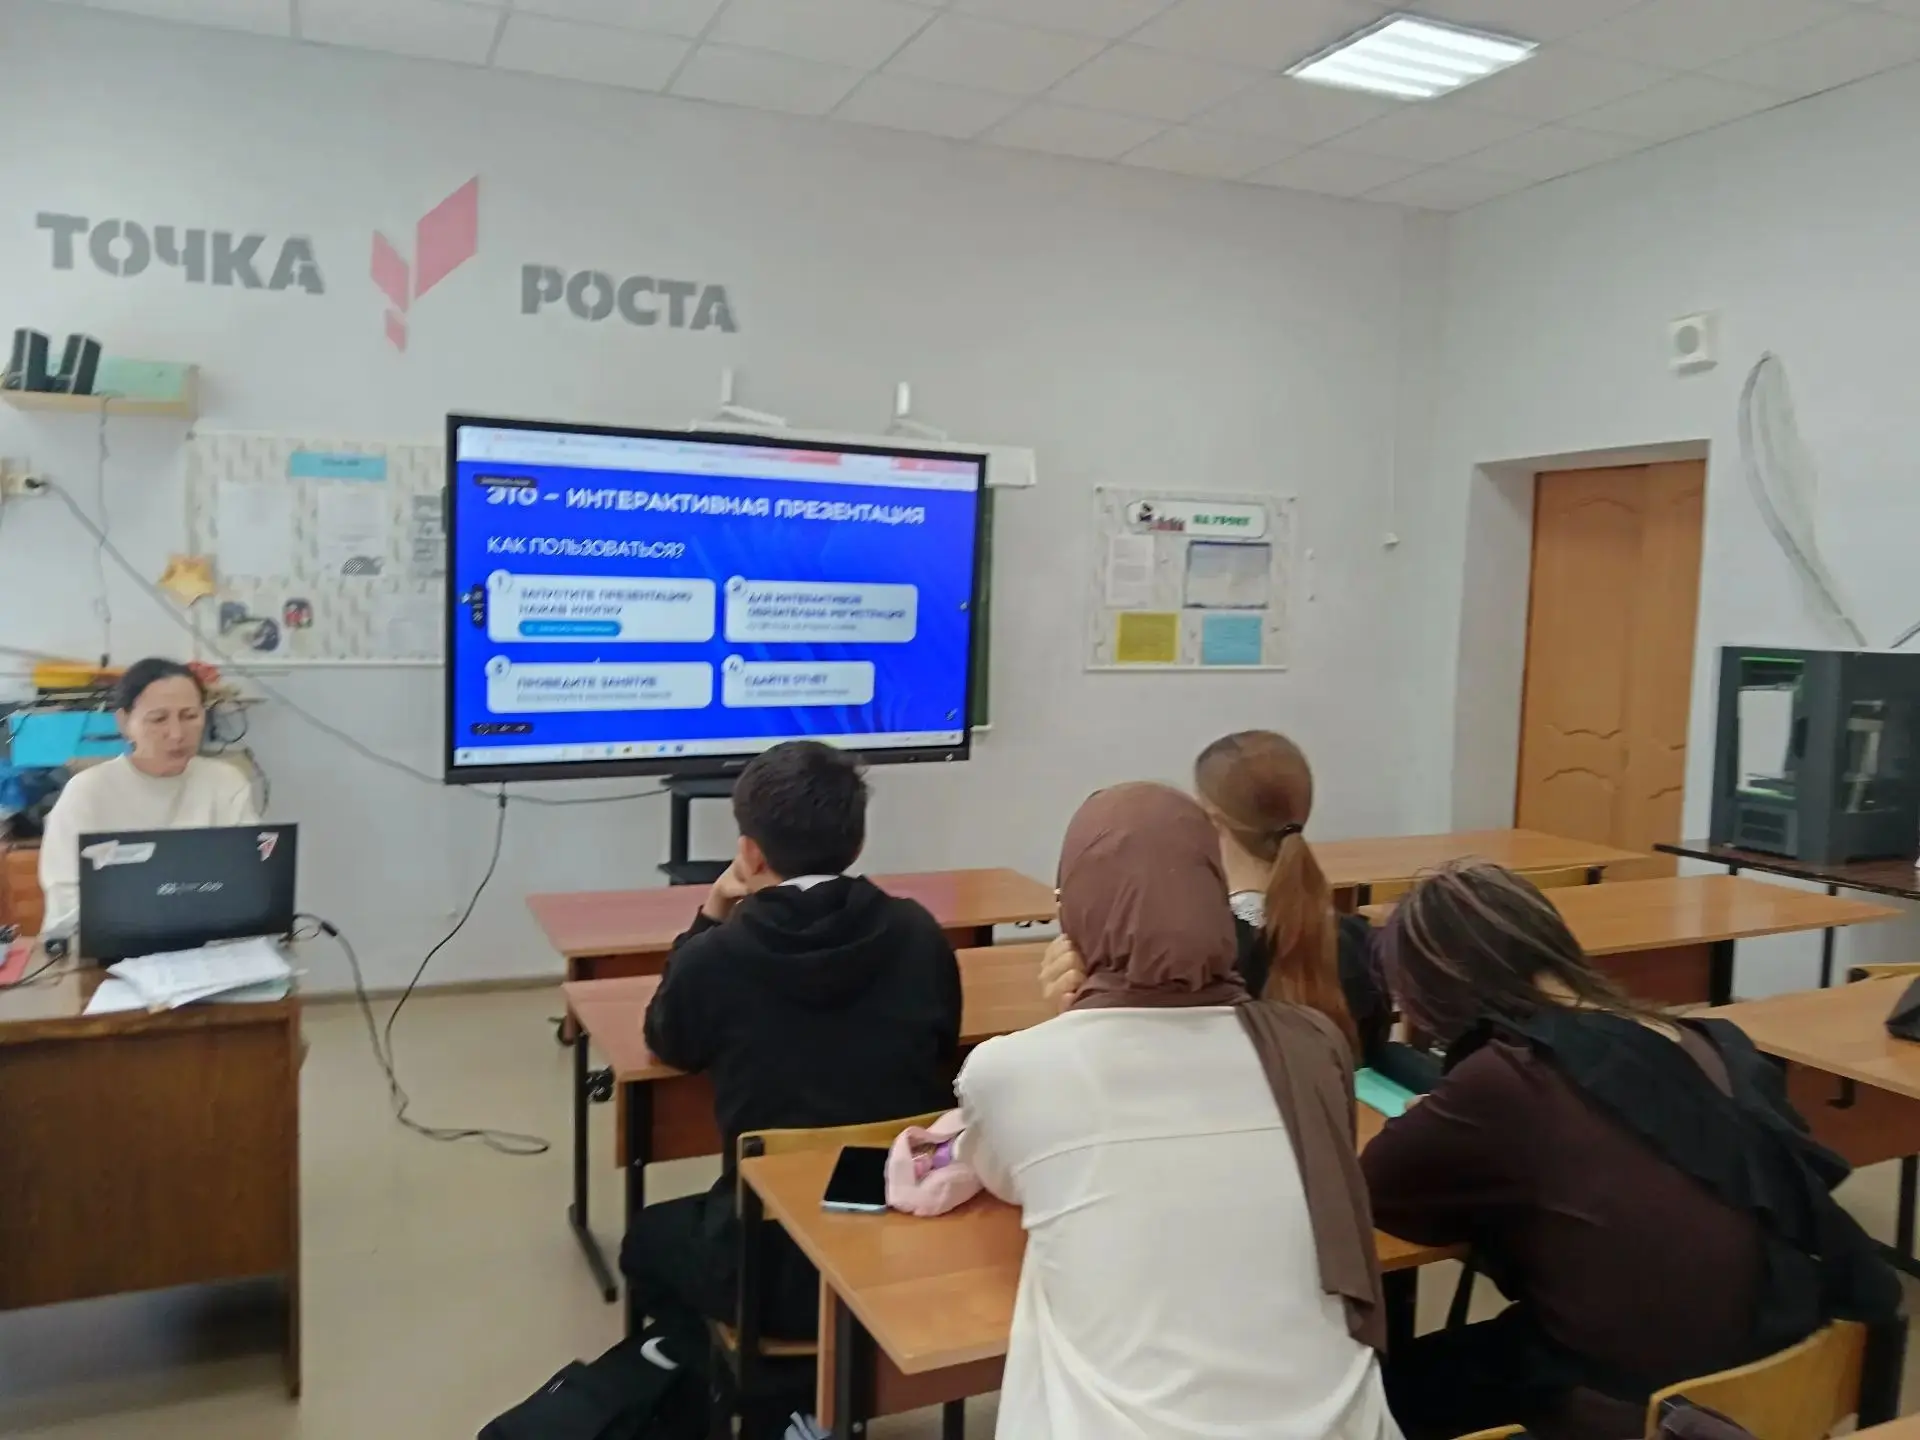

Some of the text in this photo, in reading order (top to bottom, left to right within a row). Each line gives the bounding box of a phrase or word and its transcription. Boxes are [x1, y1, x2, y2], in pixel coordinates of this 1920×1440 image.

[36, 212, 740, 333] ТОЧКА РОСТА
[486, 485, 538, 506] ЭТО
[566, 487, 770, 518] ИНТЕРАКТИВНАЯ
[774, 498, 925, 526] ПРЕЗЕНТАЦИЯ
[487, 536, 685, 559] КАК ПОЛЬЗОВАТЬСЯ?
